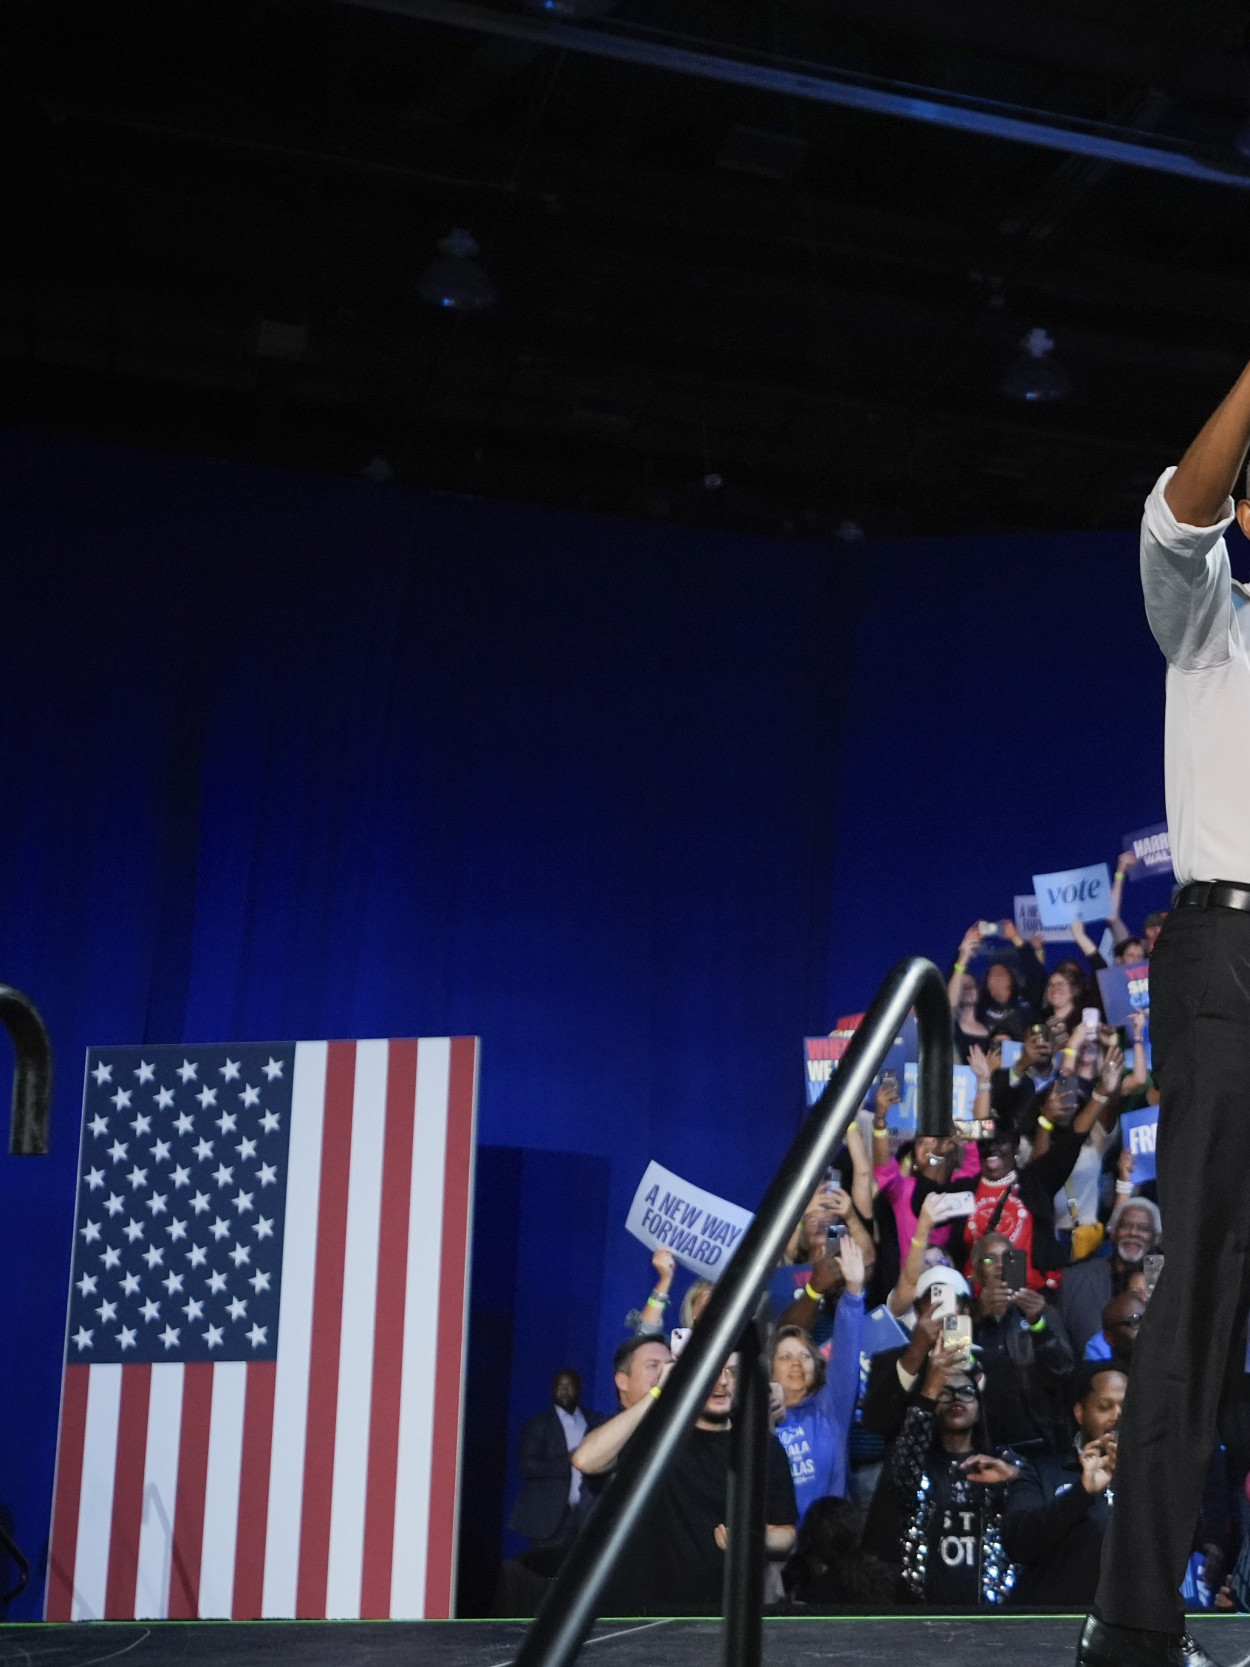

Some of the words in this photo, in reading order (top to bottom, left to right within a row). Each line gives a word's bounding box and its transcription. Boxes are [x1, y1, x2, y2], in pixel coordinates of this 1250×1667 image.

[1133, 832, 1171, 858] HARR
[1143, 850, 1172, 866] WAL
[1047, 877, 1101, 905] vote
[645, 1184, 660, 1206] A
[658, 1191, 704, 1230] NEW
[700, 1213, 743, 1248] WAY
[641, 1207, 722, 1266] FORWARD
